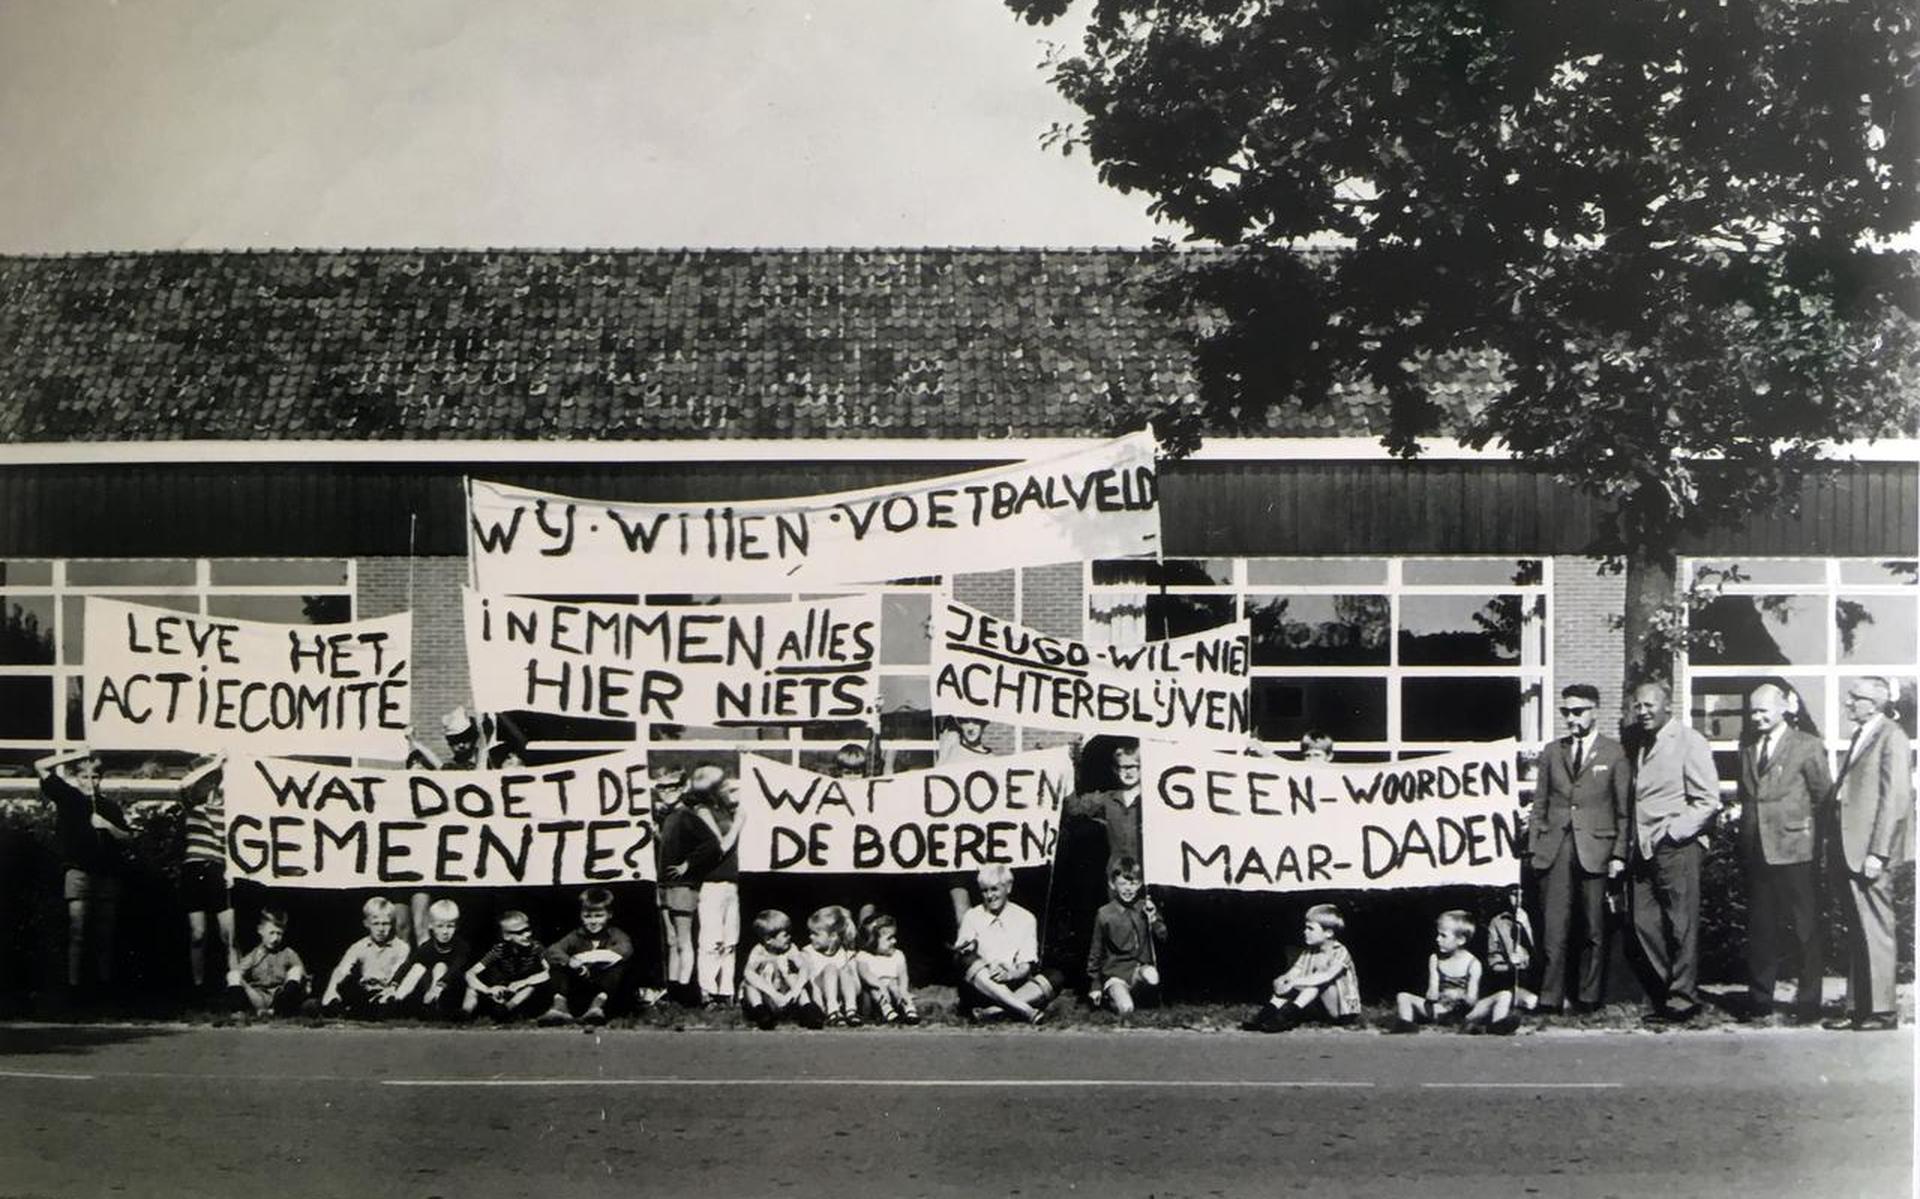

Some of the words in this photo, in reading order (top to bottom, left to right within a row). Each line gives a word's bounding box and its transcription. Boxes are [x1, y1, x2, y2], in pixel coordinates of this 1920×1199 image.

[128, 612, 240, 664] LEVE
[289, 630, 389, 678] HET
[550, 605, 764, 669] EMMEN
[525, 658, 684, 720] HIER
[254, 759, 386, 812] WAT
[410, 770, 576, 818] DOET
[598, 764, 651, 816] DE
[752, 767, 895, 817] WAT
[924, 768, 1063, 817] DOEN
[227, 814, 653, 886] GEMEENTE?
[770, 823, 834, 869] DE
